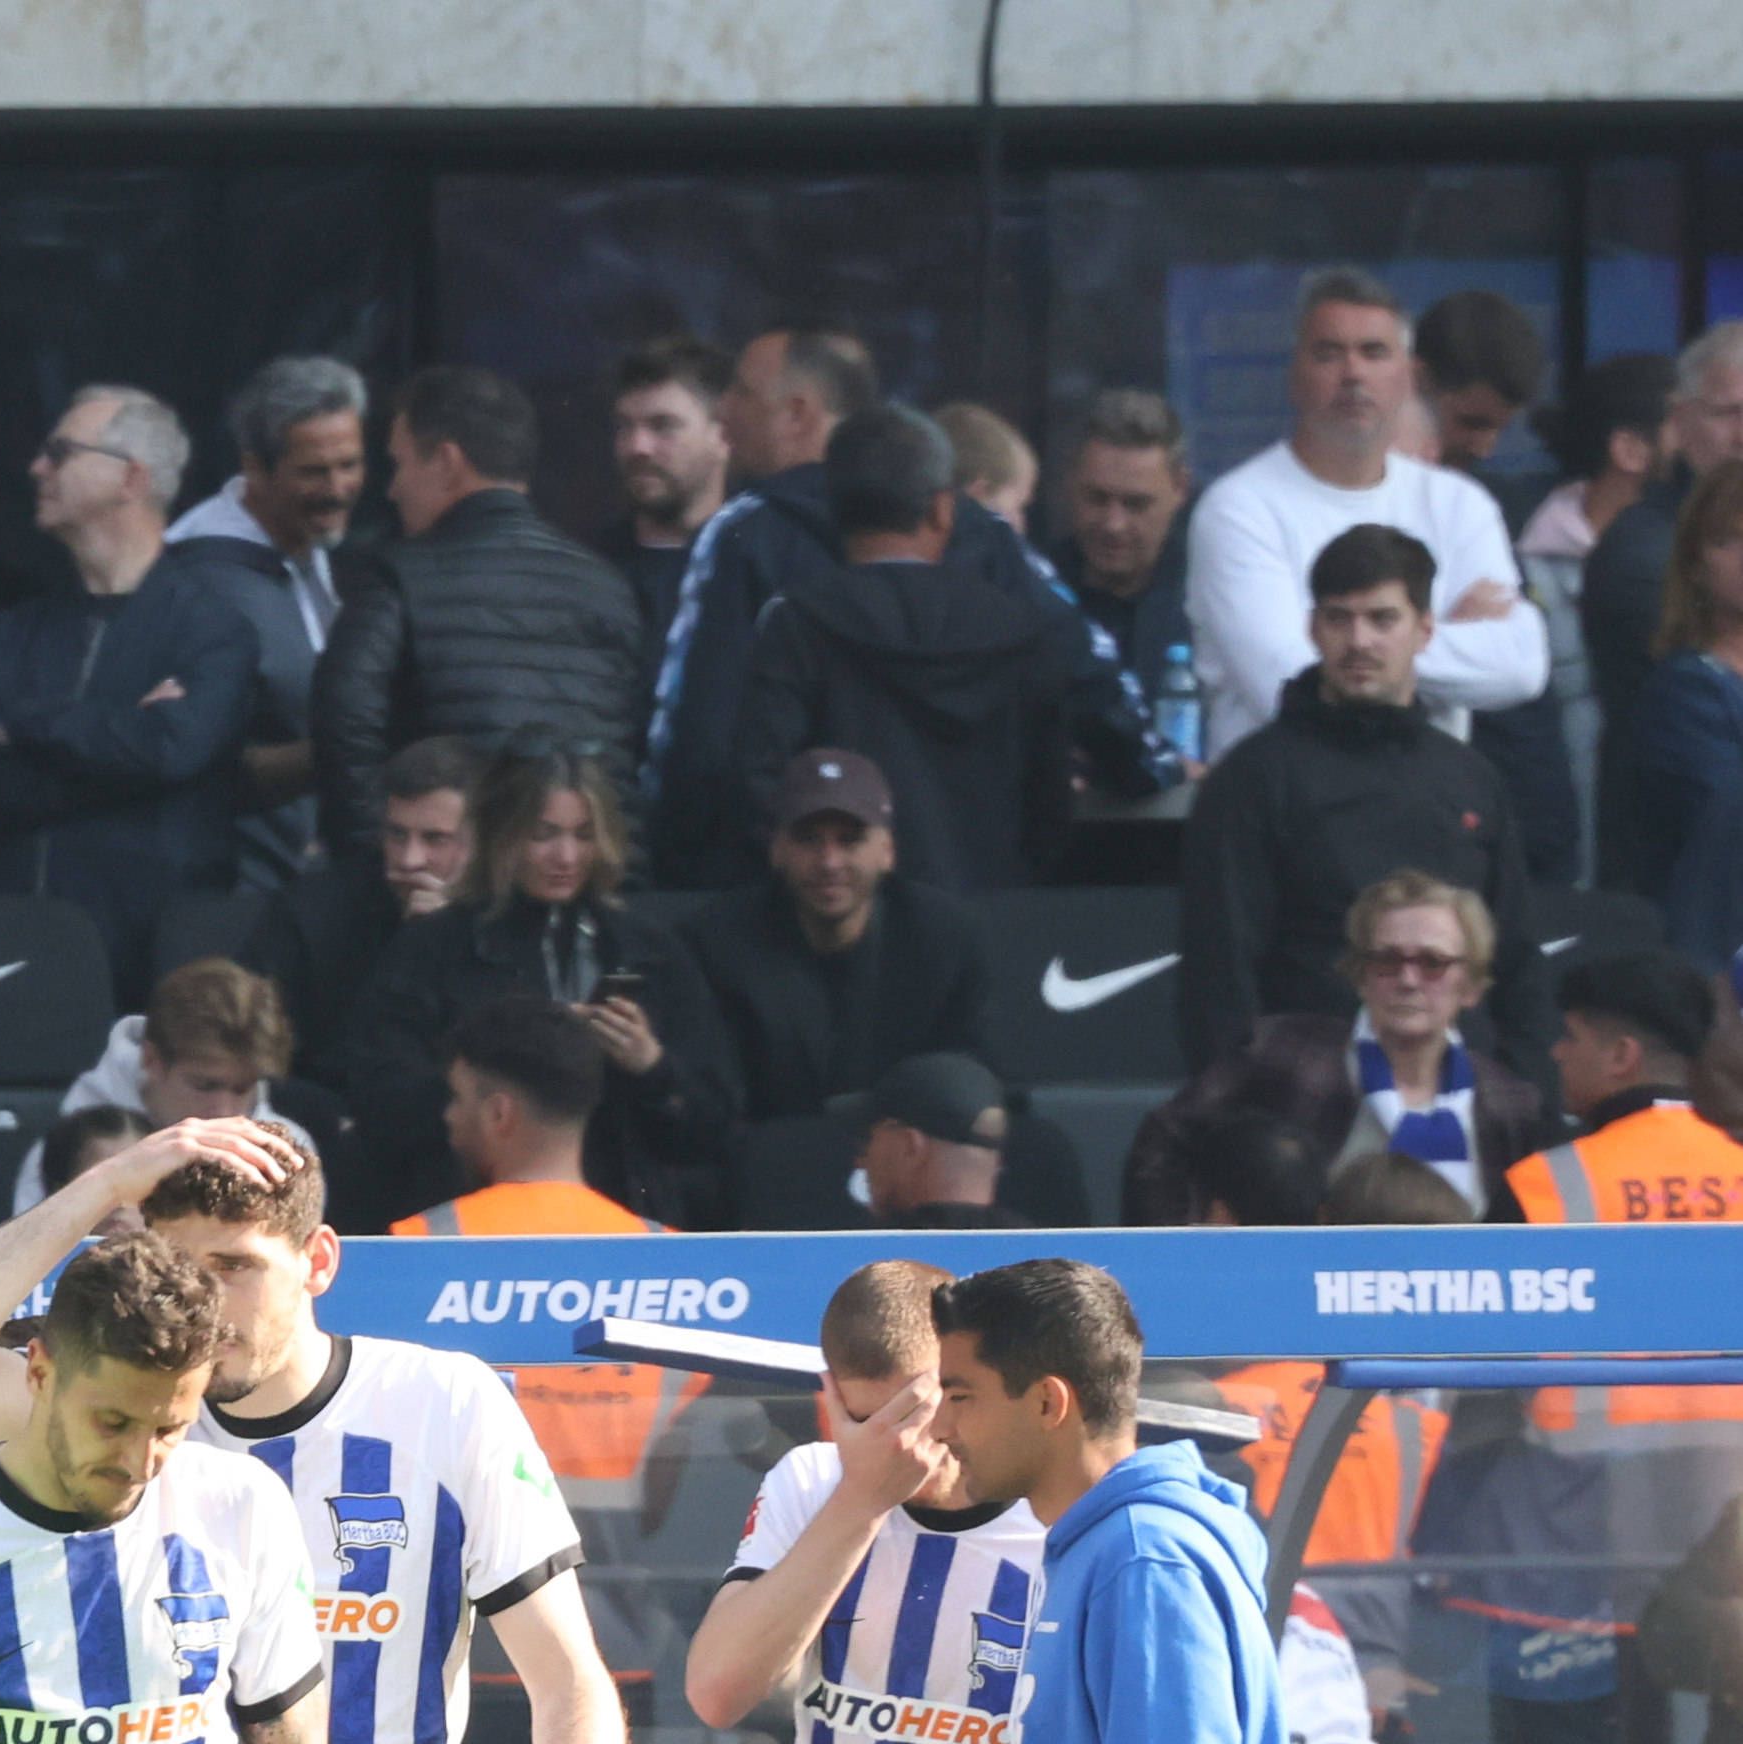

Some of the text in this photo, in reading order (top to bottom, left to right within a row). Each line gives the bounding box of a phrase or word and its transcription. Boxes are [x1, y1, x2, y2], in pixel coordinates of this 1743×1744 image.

[1621, 1176, 1743, 1221] BES
[426, 1278, 750, 1324] AUTOHERO
[1314, 1268, 1595, 1314] HERTHA BSC
